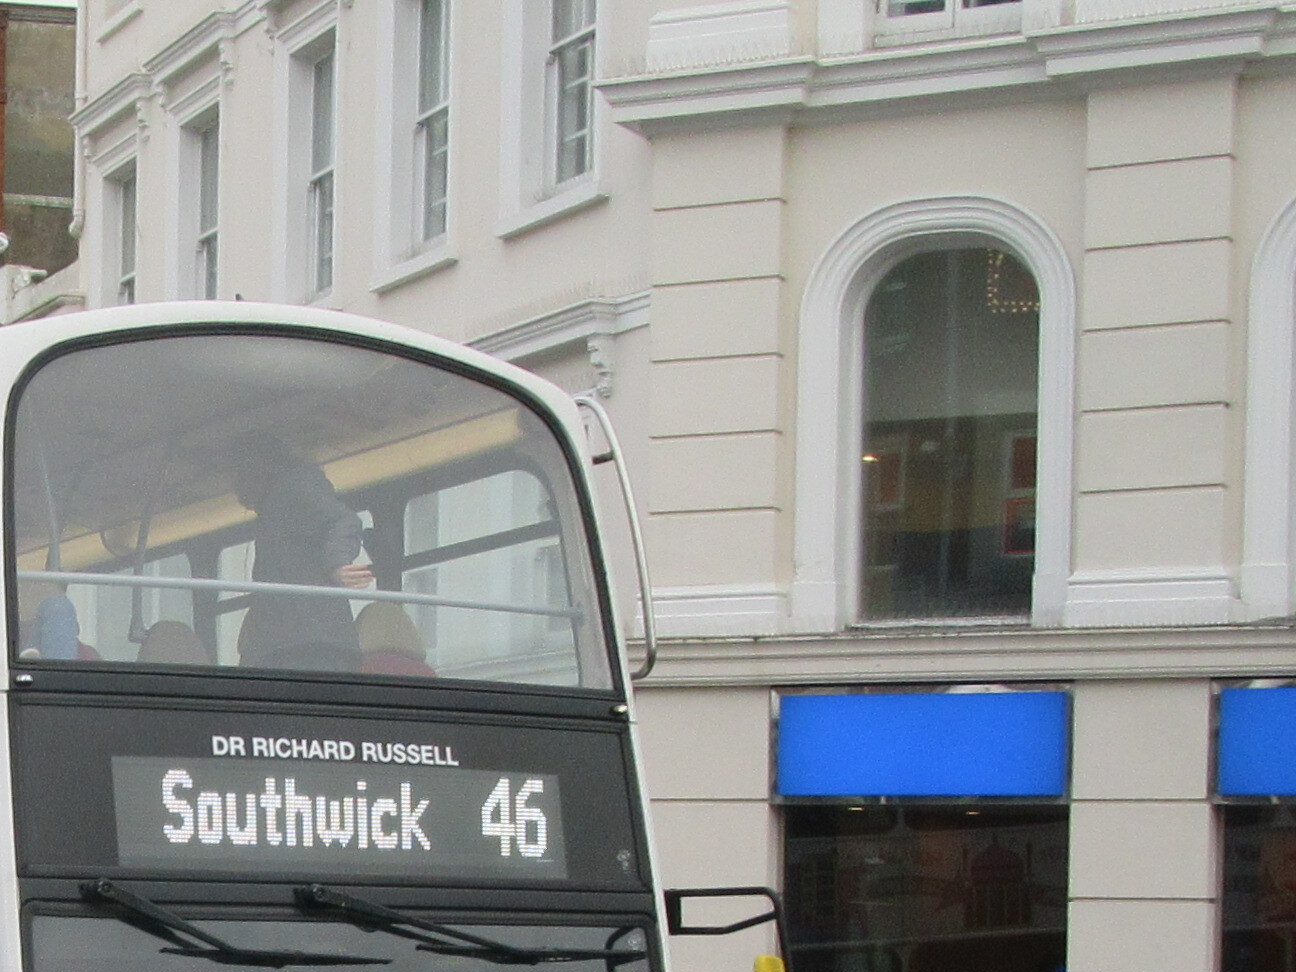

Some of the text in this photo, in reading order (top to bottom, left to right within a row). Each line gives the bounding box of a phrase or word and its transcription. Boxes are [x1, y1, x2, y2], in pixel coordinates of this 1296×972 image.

[211, 735, 460, 767] DR RICHARD RUSSELL
[161, 769, 548, 858] Southwick 46
